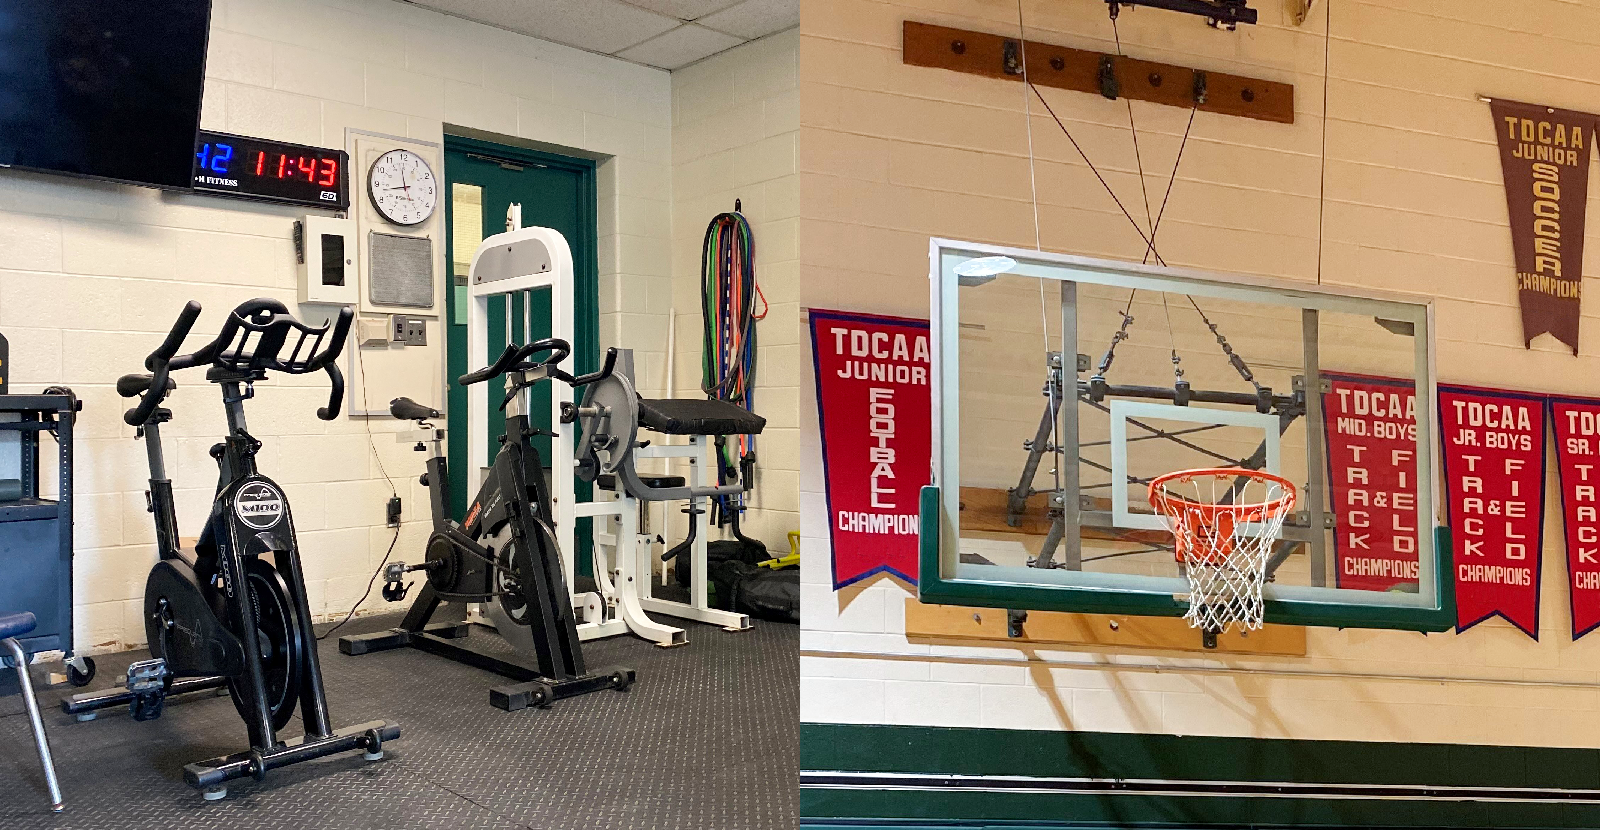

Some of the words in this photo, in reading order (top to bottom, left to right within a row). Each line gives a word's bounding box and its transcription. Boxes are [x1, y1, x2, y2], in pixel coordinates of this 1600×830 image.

[1504, 116, 1583, 149] TDCAA
[1512, 142, 1578, 166] JUNIOR
[206, 176, 238, 187] FITNESS
[256, 151, 336, 186] 11:43
[1532, 162, 1561, 277] SOCCER
[830, 327, 930, 363] TDCAA
[837, 360, 926, 385] JUNIOR
[1336, 388, 1416, 419] TDCAA
[1453, 400, 1531, 431] TDCAA
[1337, 417, 1371, 437] MID.
[1373, 421, 1416, 441] BOYS
[1453, 429, 1481, 447] JR.
[1486, 432, 1532, 451] BOYS
[869, 387, 896, 508] FOOTBALL
[1567, 438, 1594, 455] SR.
[1346, 445, 1370, 549] TRACK
[1373, 491, 1387, 507] &
[1391, 449, 1414, 553] FIELD
[1461, 455, 1485, 557] TRACK
[1488, 500, 1501, 515] &
[1505, 459, 1526, 560] FIELD
[838, 510, 919, 535] CHAMPION
[1574, 465, 1599, 563] TRACK
[1344, 557, 1419, 579] CHAMPIONS
[1459, 564, 1531, 586] CHAMPIONS
[1576, 571, 1600, 590] CHA
